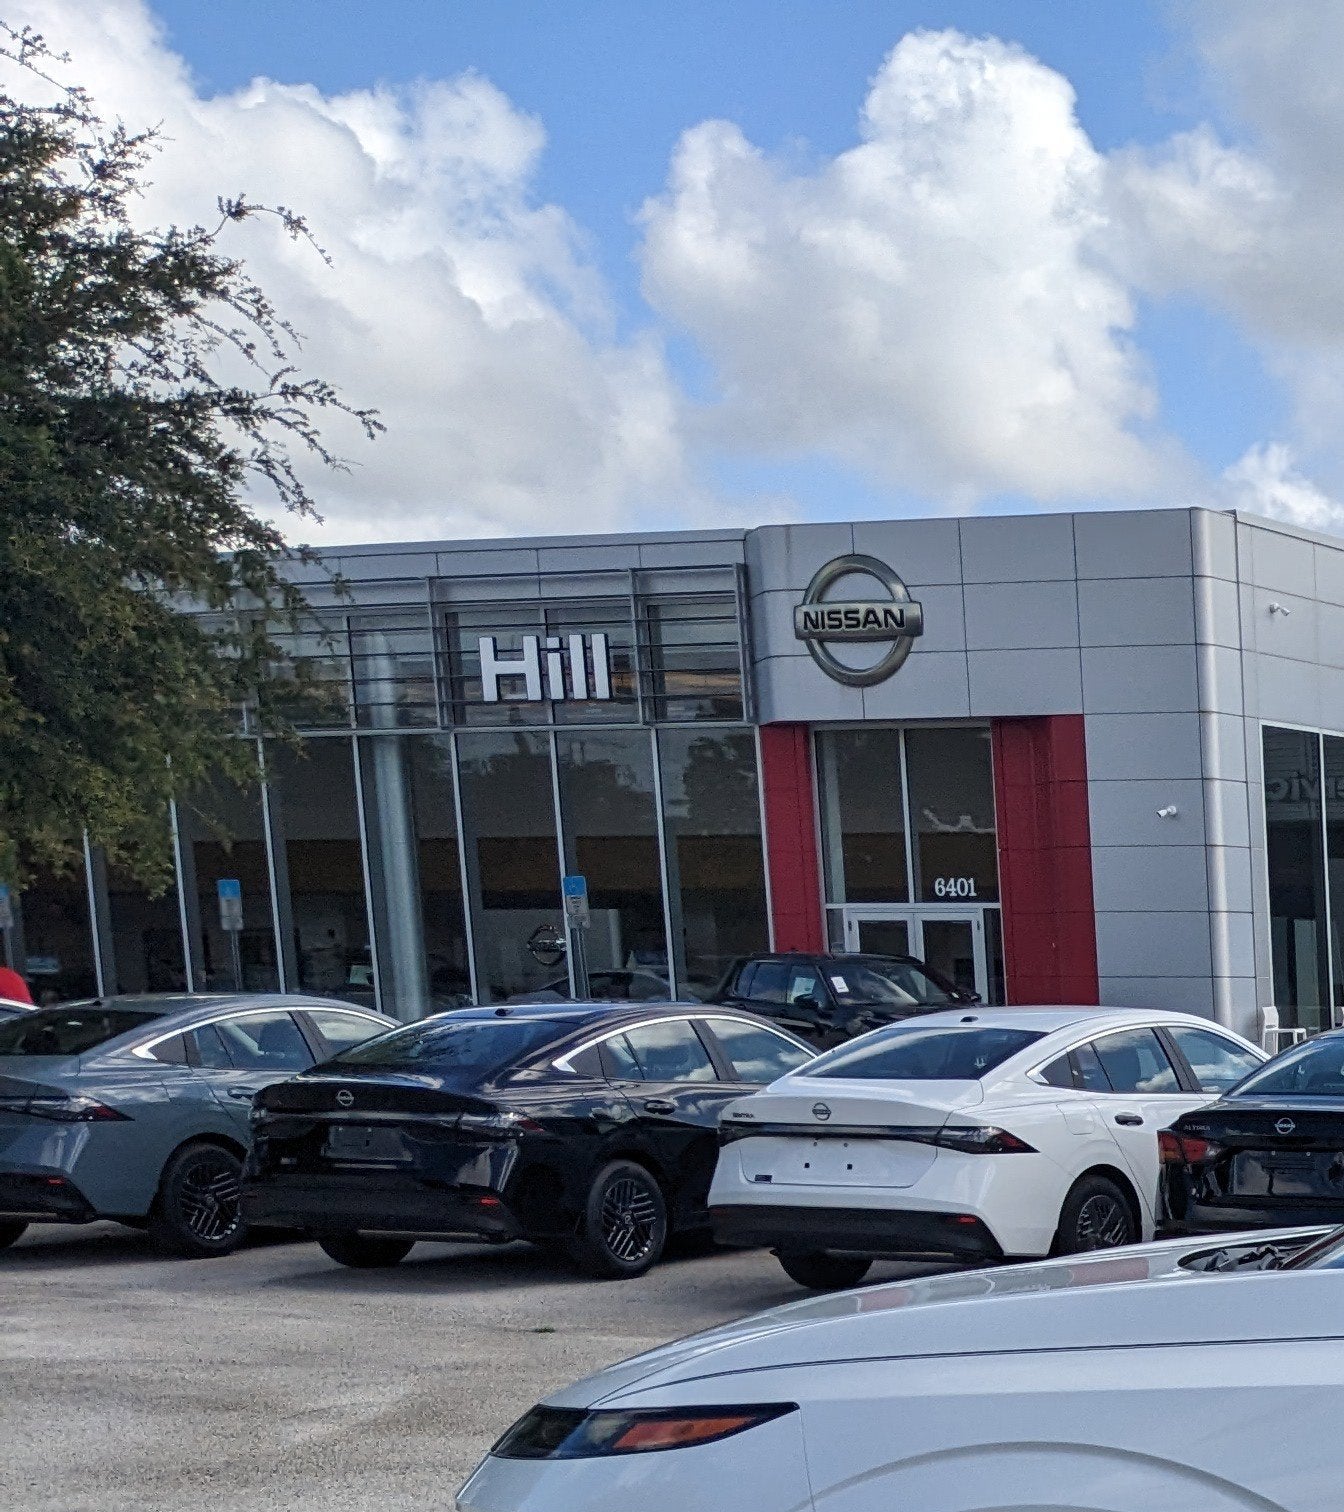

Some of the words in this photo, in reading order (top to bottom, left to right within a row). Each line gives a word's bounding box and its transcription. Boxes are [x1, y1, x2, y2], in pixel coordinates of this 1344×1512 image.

[803, 607, 906, 630] NISSAN
[478, 632, 609, 702] Hill
[934, 877, 978, 897] 6401
